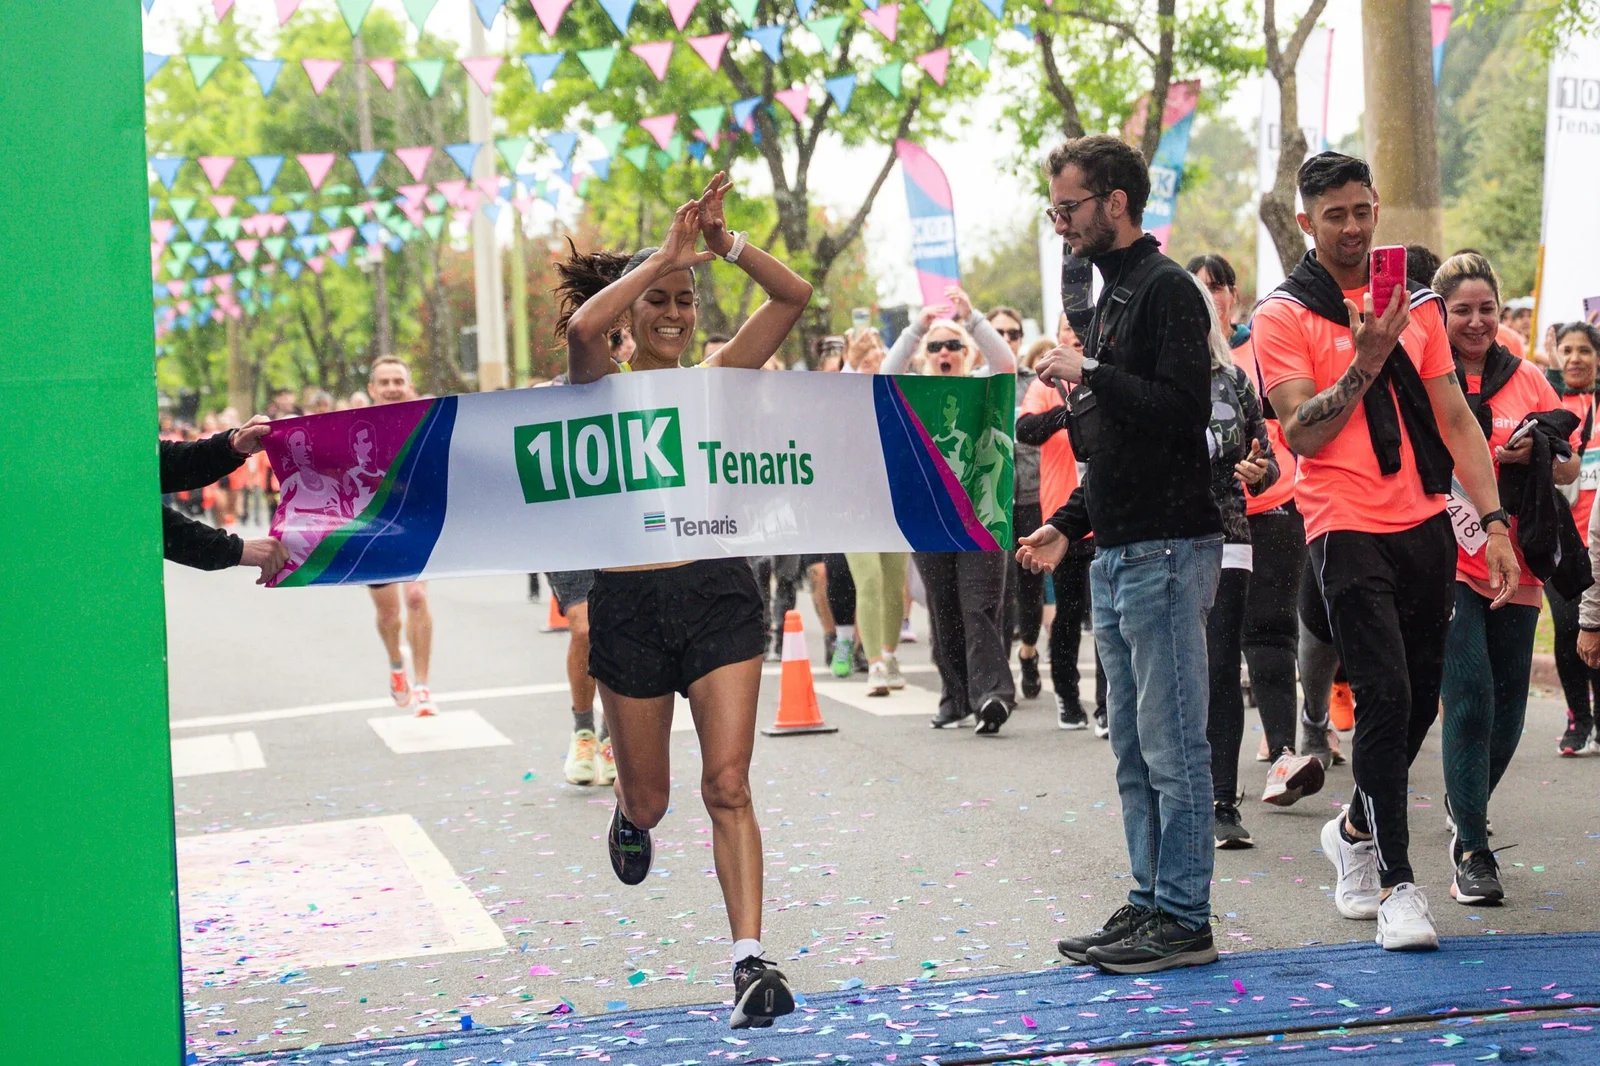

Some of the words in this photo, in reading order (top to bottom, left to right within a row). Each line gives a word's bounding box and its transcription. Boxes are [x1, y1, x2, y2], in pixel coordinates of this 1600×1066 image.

[1492, 416, 1520, 429] aris
[524, 414, 681, 495] 10K
[698, 440, 814, 485] Tenaris
[1579, 469, 1600, 483] 94
[670, 515, 737, 537] Tenaris
